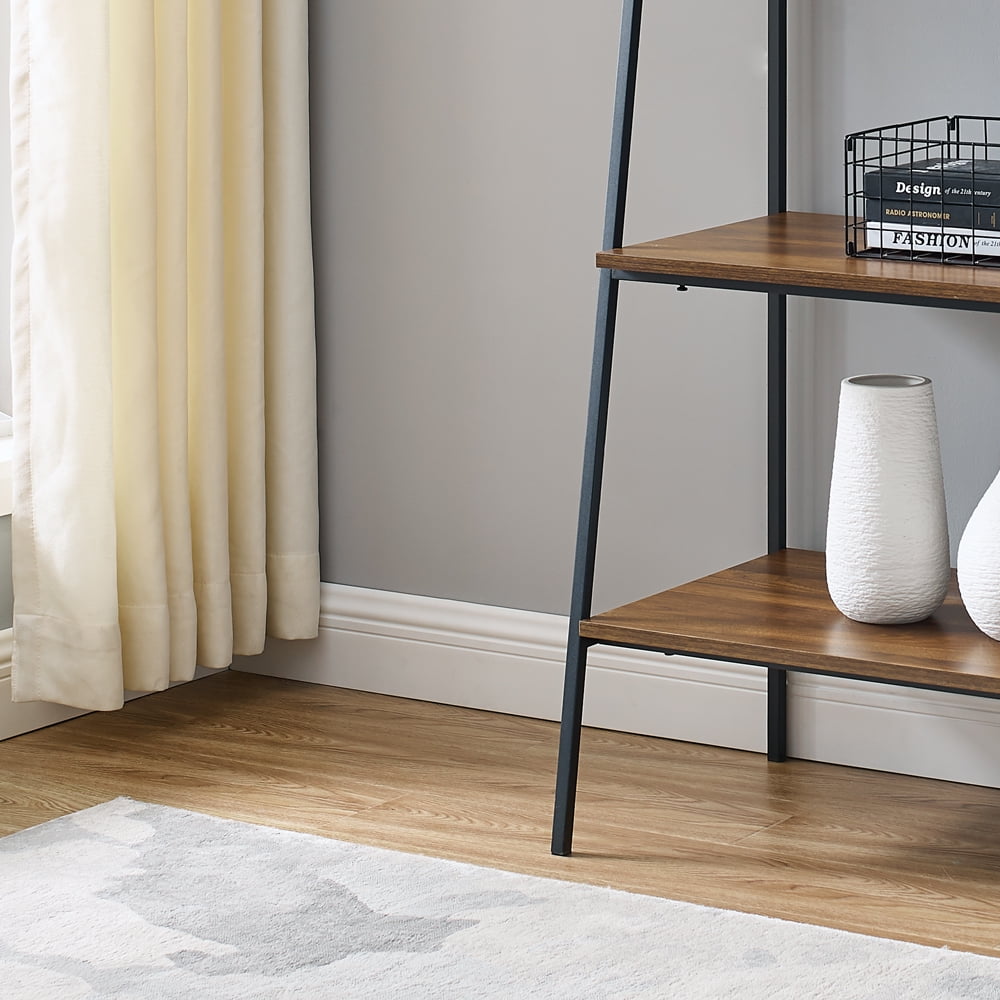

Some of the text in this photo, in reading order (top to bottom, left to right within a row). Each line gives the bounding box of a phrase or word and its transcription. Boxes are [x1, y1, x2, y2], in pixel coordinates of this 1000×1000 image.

[895, 181, 942, 198] Design
[944, 187, 951, 195] of
[885, 208, 906, 216] RADIO
